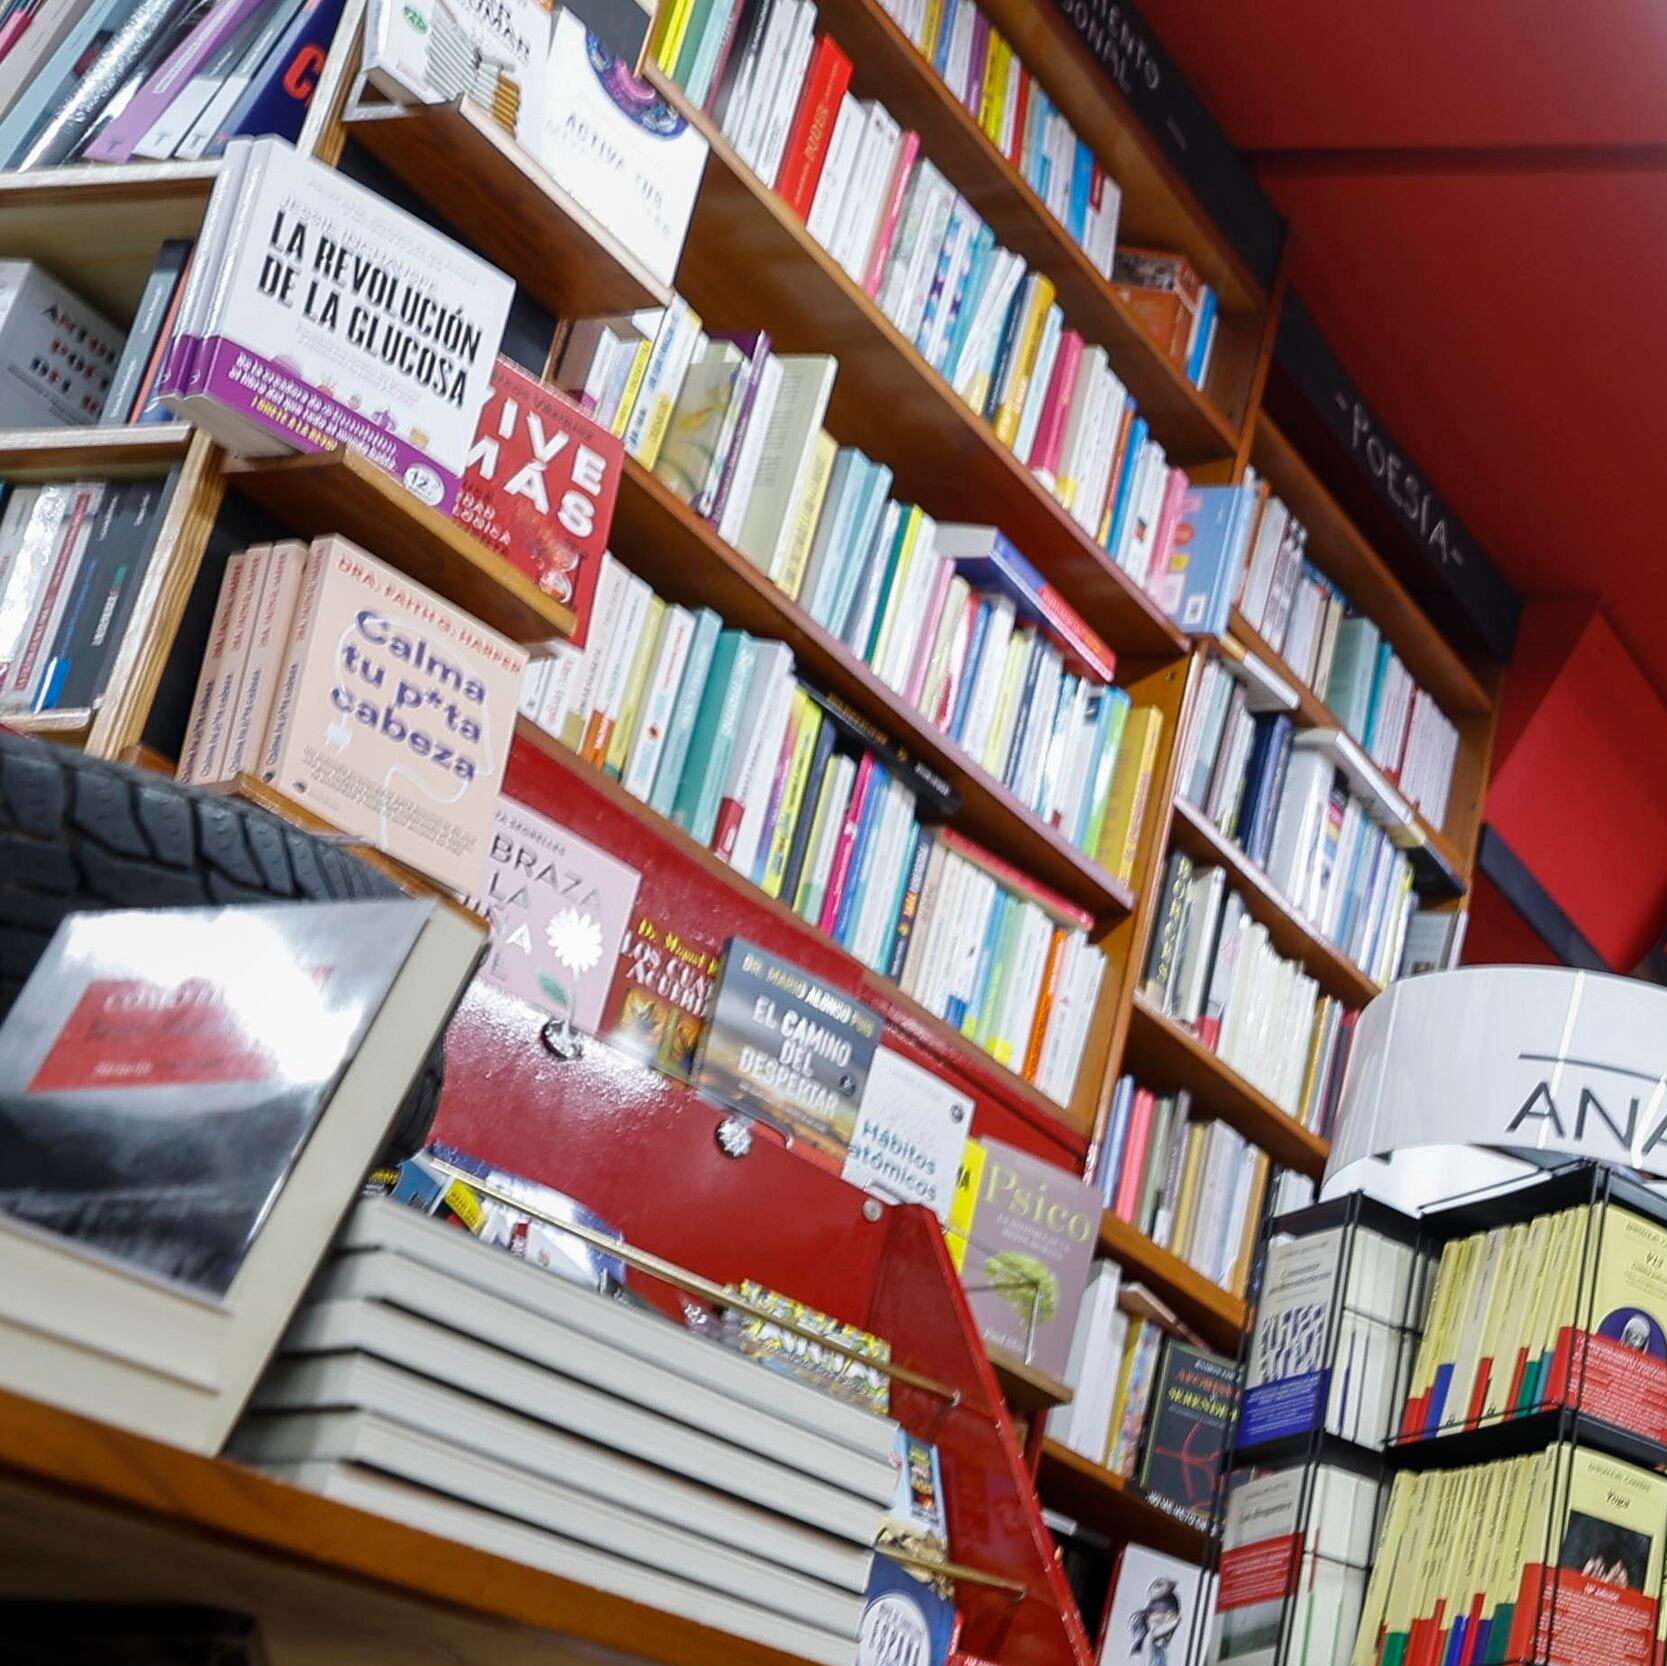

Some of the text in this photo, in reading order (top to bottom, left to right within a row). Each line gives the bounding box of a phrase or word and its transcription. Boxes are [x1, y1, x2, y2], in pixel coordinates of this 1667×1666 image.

[269, 209, 306, 263] LA
[313, 236, 483, 368] REVOLUCIÓN
[257, 254, 300, 311] DE
[302, 278, 341, 333] LA
[347, 306, 469, 411] GLUCOSA
[342, 643, 385, 690] tu
[355, 609, 486, 703] Calma
[331, 686, 477, 782] cabeza
[752, 995, 854, 1070] EL CAMINO
[805, 980, 853, 1026] ALONSO
[737, 1047, 842, 1120] DESPERTAR
[779, 1037, 815, 1079] DEL
[847, 1142, 938, 1203] atómicos
[861, 1117, 938, 1177] Hábitos
[984, 1163, 1093, 1245] Psico
